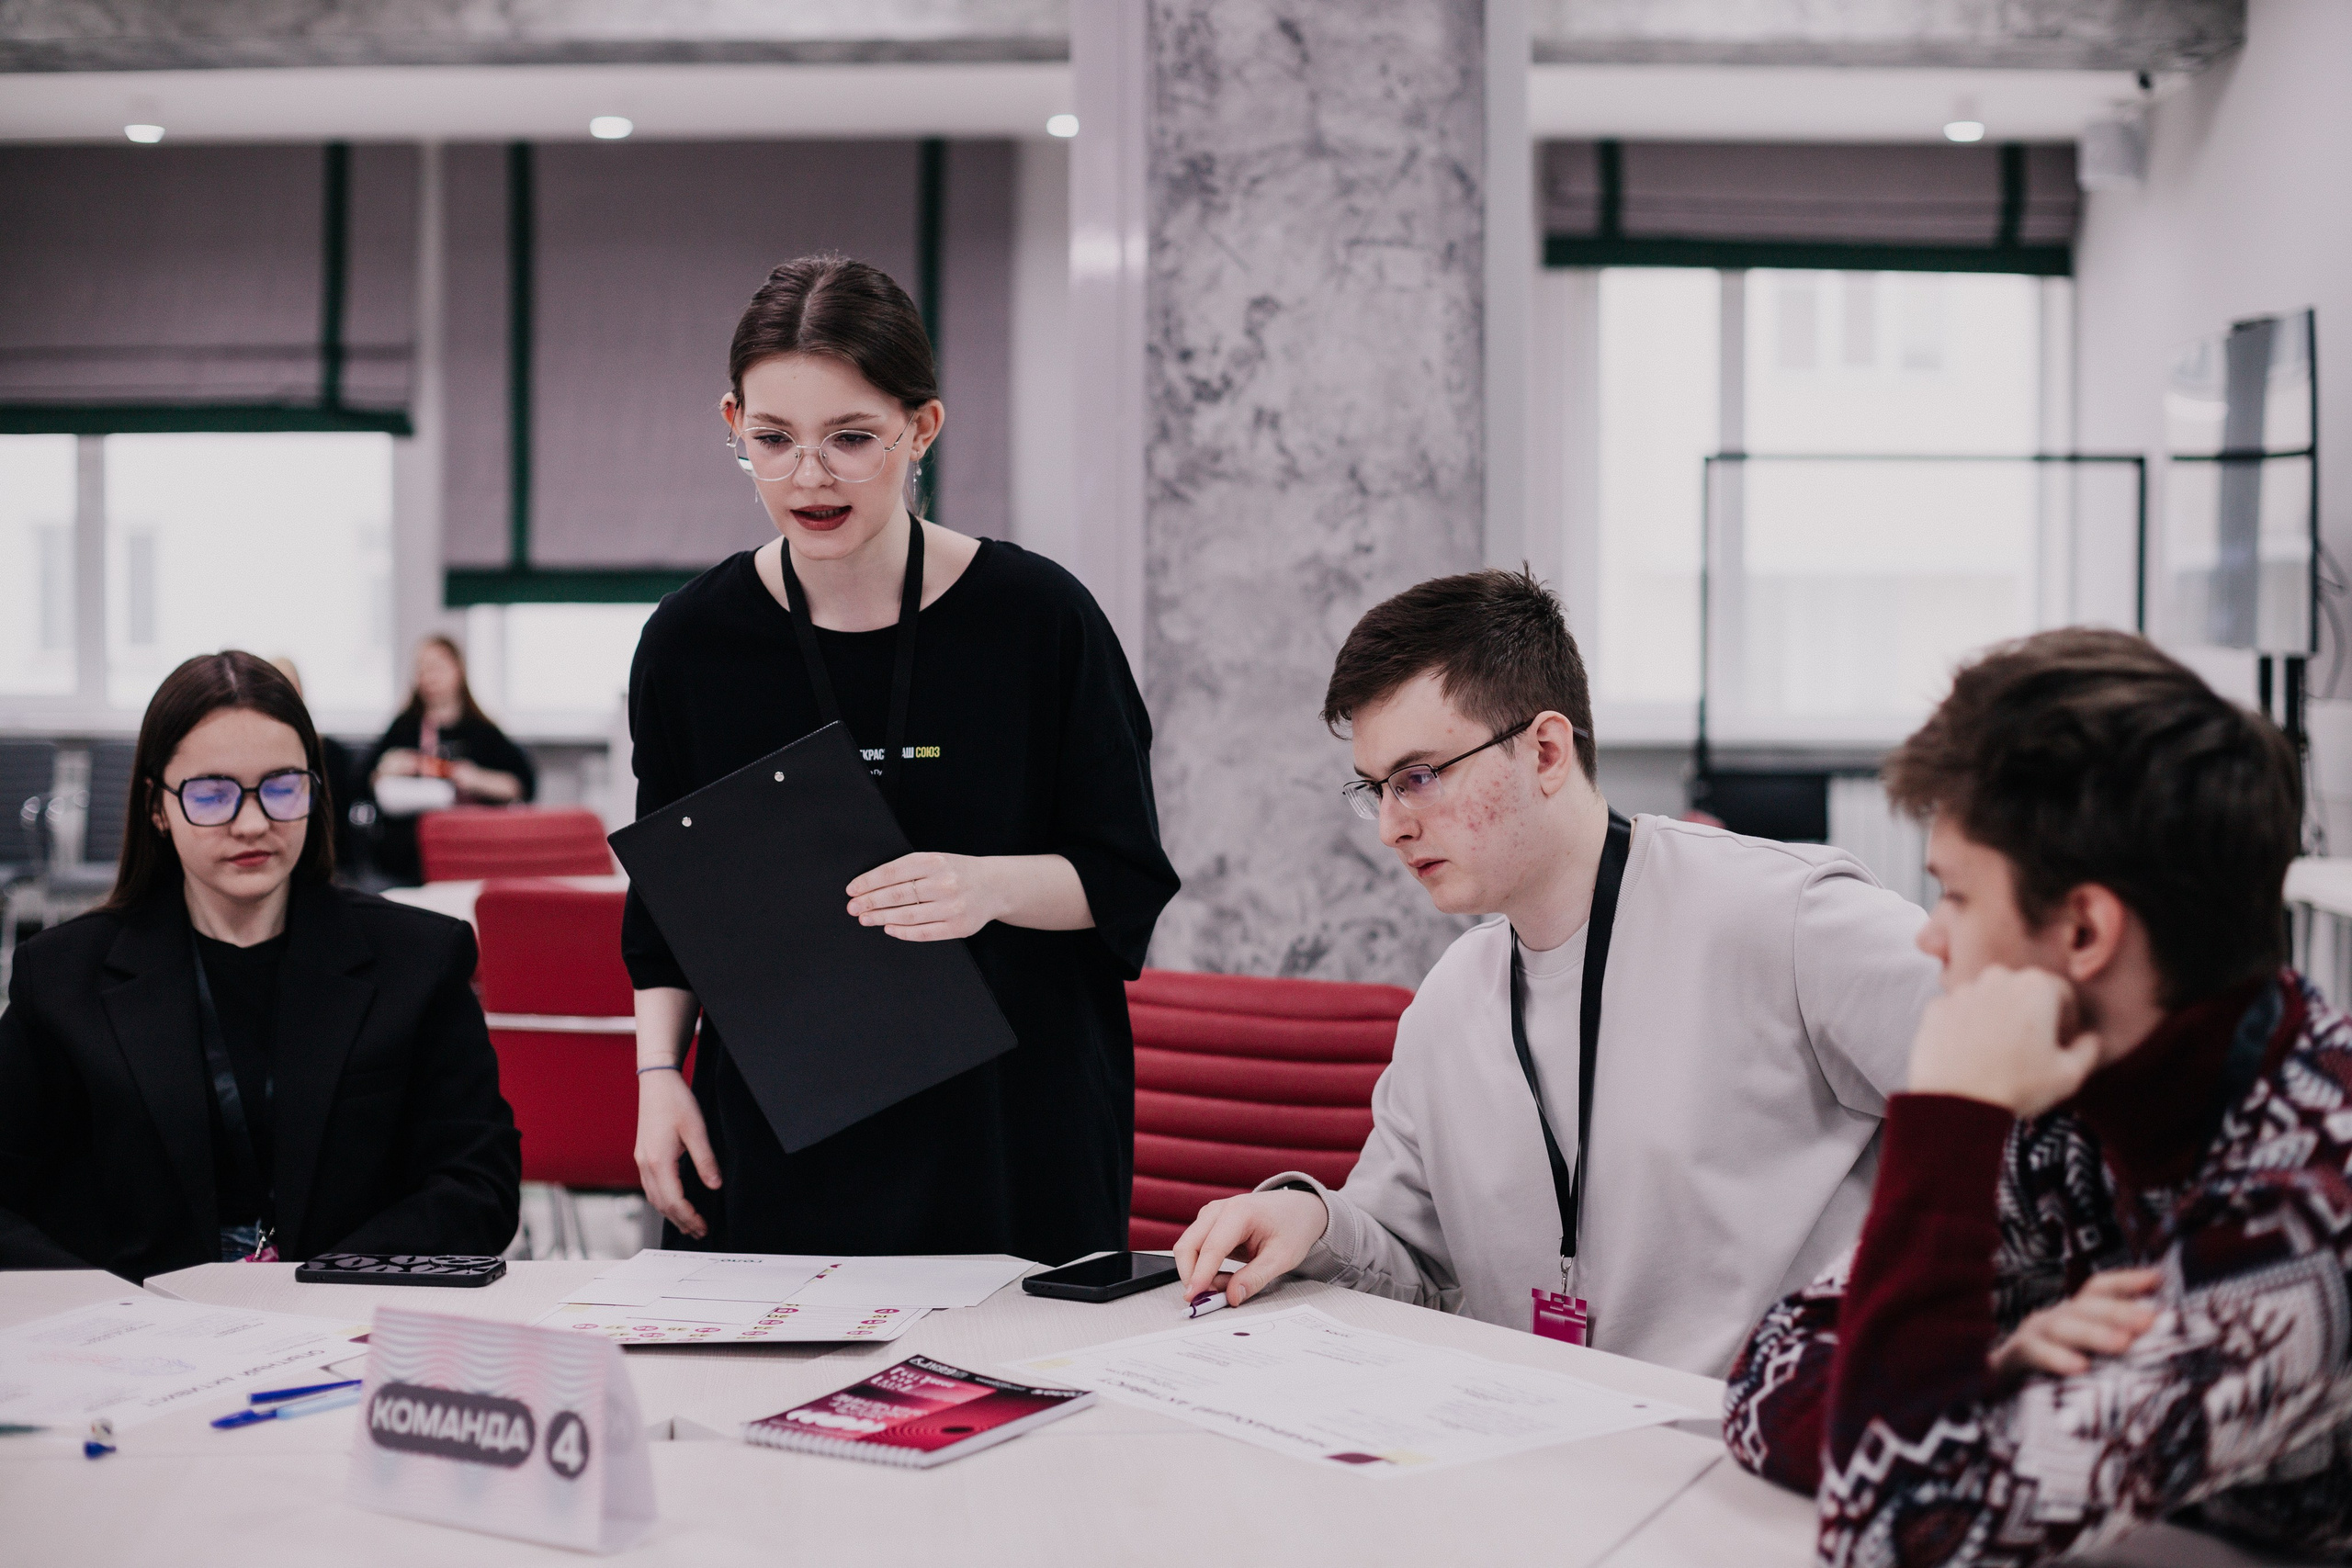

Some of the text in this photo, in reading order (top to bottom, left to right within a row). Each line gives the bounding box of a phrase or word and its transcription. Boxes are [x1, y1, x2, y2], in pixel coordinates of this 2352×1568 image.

[860, 746, 941, 761] КРАС АШ СОЮЗ
[370, 1395, 583, 1472] КОМАНДА 4
